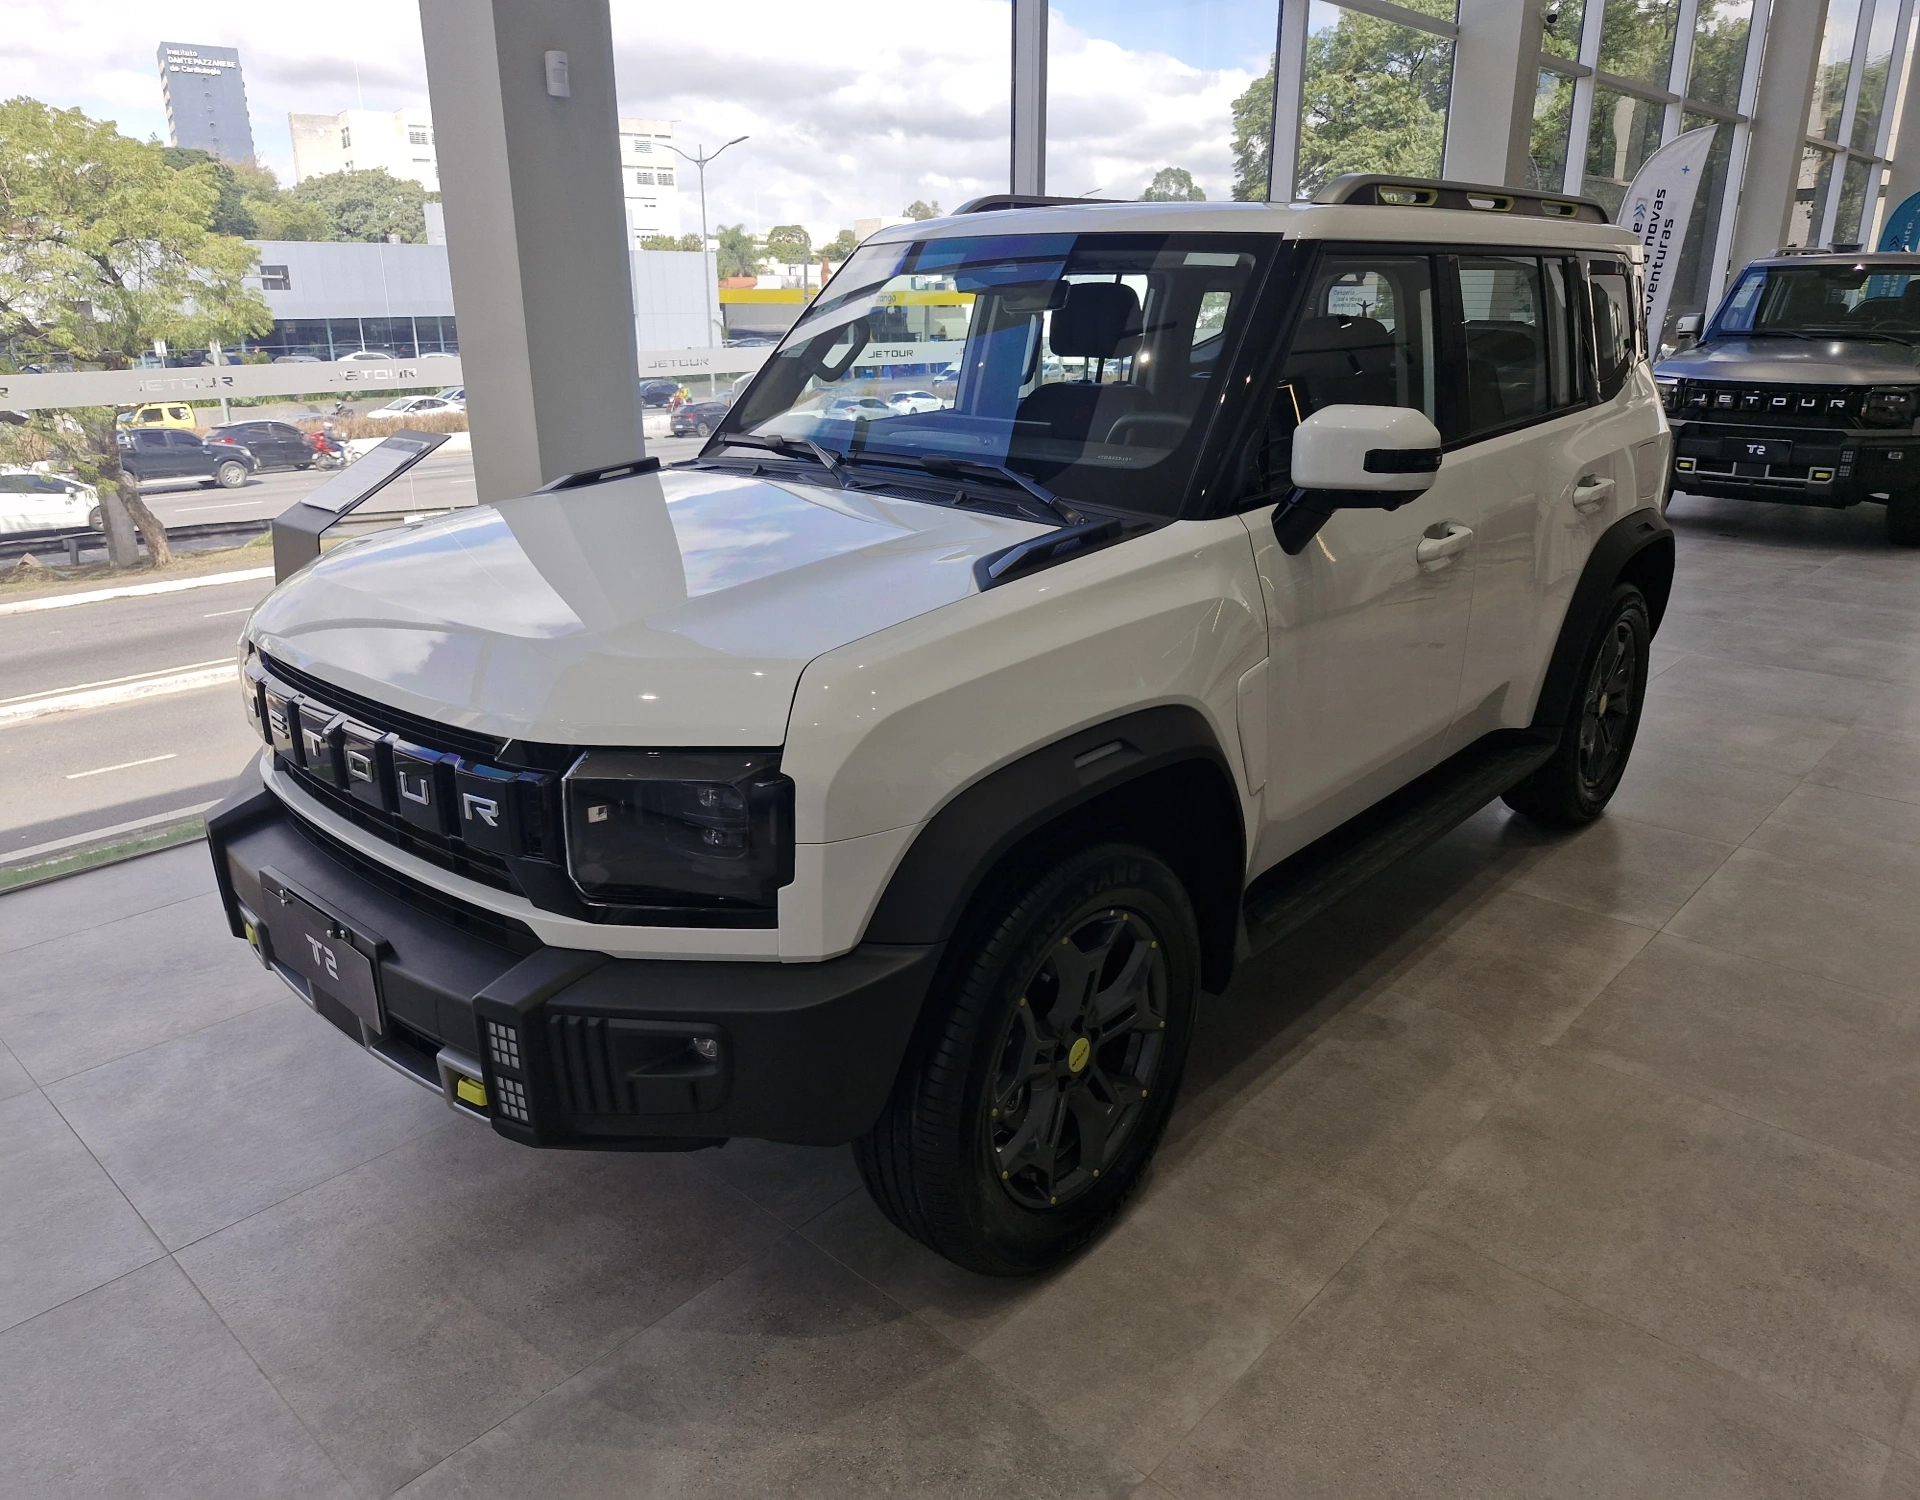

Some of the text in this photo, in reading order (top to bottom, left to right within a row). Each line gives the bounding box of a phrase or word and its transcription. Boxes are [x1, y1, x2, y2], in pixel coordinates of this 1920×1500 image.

[166, 48, 198, 57] Instituto
[168, 56, 194, 65] DANTE
[169, 64, 222, 76] de Cardiologia
[1645, 188, 1666, 247] novas
[868, 349, 914, 359] JETOUR
[648, 358, 709, 369] JETOUR
[329, 367, 418, 382] JETOUR
[1691, 393, 1846, 408] JETOUR
[1746, 444, 1766, 455] T2
[304, 932, 340, 981] T2
